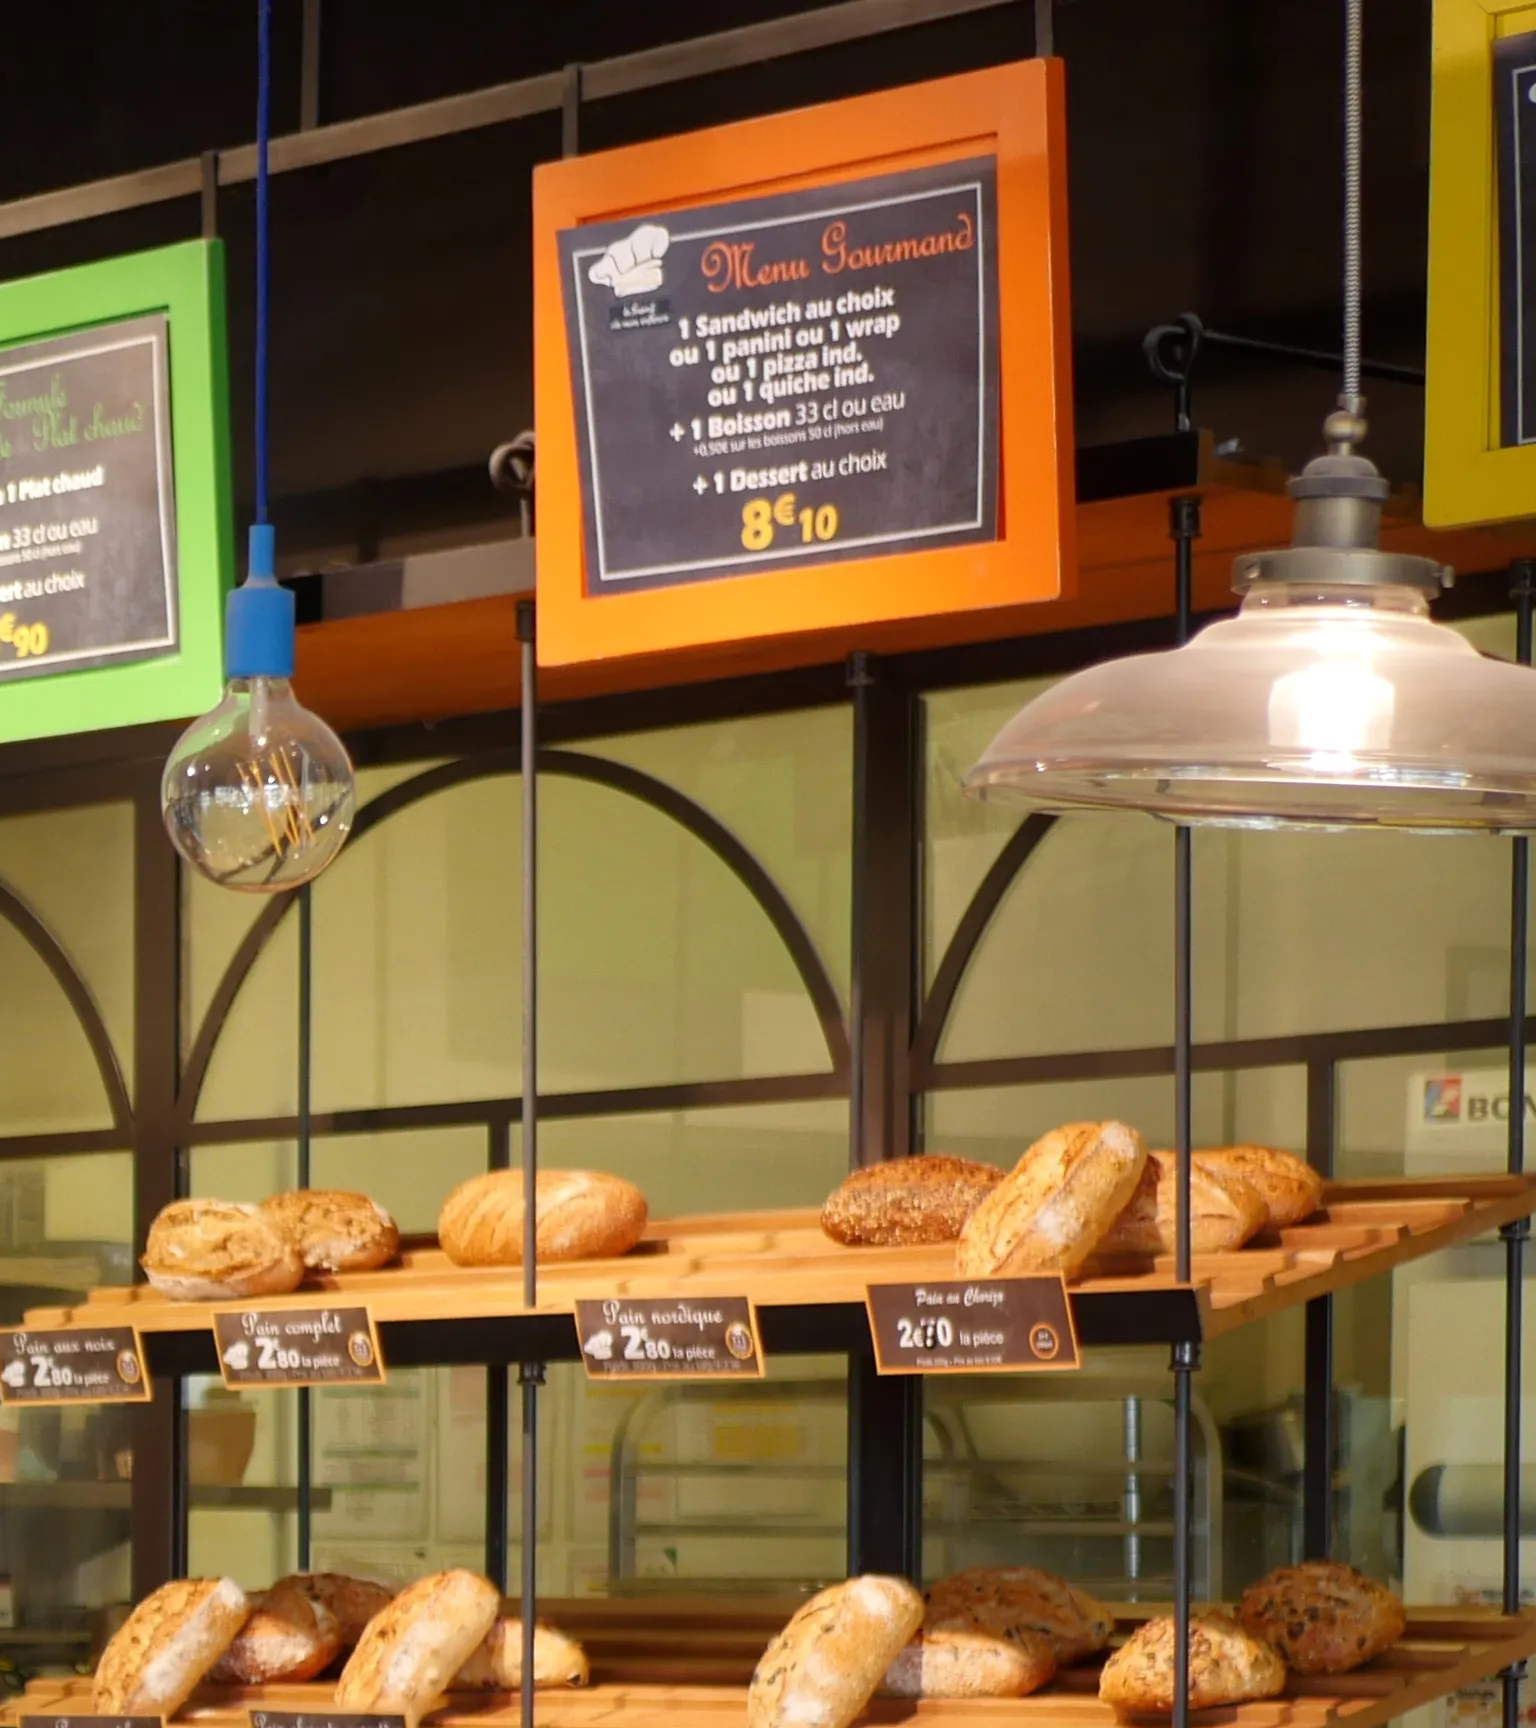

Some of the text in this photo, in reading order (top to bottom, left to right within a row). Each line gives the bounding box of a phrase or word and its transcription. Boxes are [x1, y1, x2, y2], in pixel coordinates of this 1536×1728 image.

[701, 213, 975, 293] Menu Gourmand
[678, 318, 690, 340] 1
[696, 305, 800, 338] Sandwich
[805, 298, 832, 320] au
[836, 286, 894, 314] choix
[670, 314, 900, 366] ou 1 panini ou 1 wrap
[711, 342, 863, 384] ou 1 pizza ind.
[708, 364, 874, 407] ou 1 quiche ind.
[691, 418, 702, 441] 1
[708, 408, 791, 438] Boisson
[795, 402, 818, 426] 33
[823, 399, 837, 420] cl
[842, 397, 866, 416] ou
[870, 391, 906, 412] eau
[7, 483, 17, 503] 1
[19, 477, 51, 501] Plat
[53, 465, 105, 494] chaud
[713, 472, 725, 494] 1
[730, 461, 808, 491] Dessert
[811, 461, 835, 479] au
[838, 448, 888, 477] choix
[12, 528, 31, 548] 33
[47, 522, 68, 541] ou
[69, 517, 98, 538] eau
[740, 492, 839, 551] 8€10
[23, 578, 42, 599] au
[44, 570, 86, 594] choix
[915, 1286, 943, 1306] Pain
[241, 1309, 342, 1343] Pain complet
[602, 1300, 723, 1332] Pain nordique
[13, 1332, 116, 1355] Pain aux noix
[672, 1346, 683, 1359] la
[685, 1344, 715, 1361] pièce
[959, 1331, 1004, 1348] la pièce
